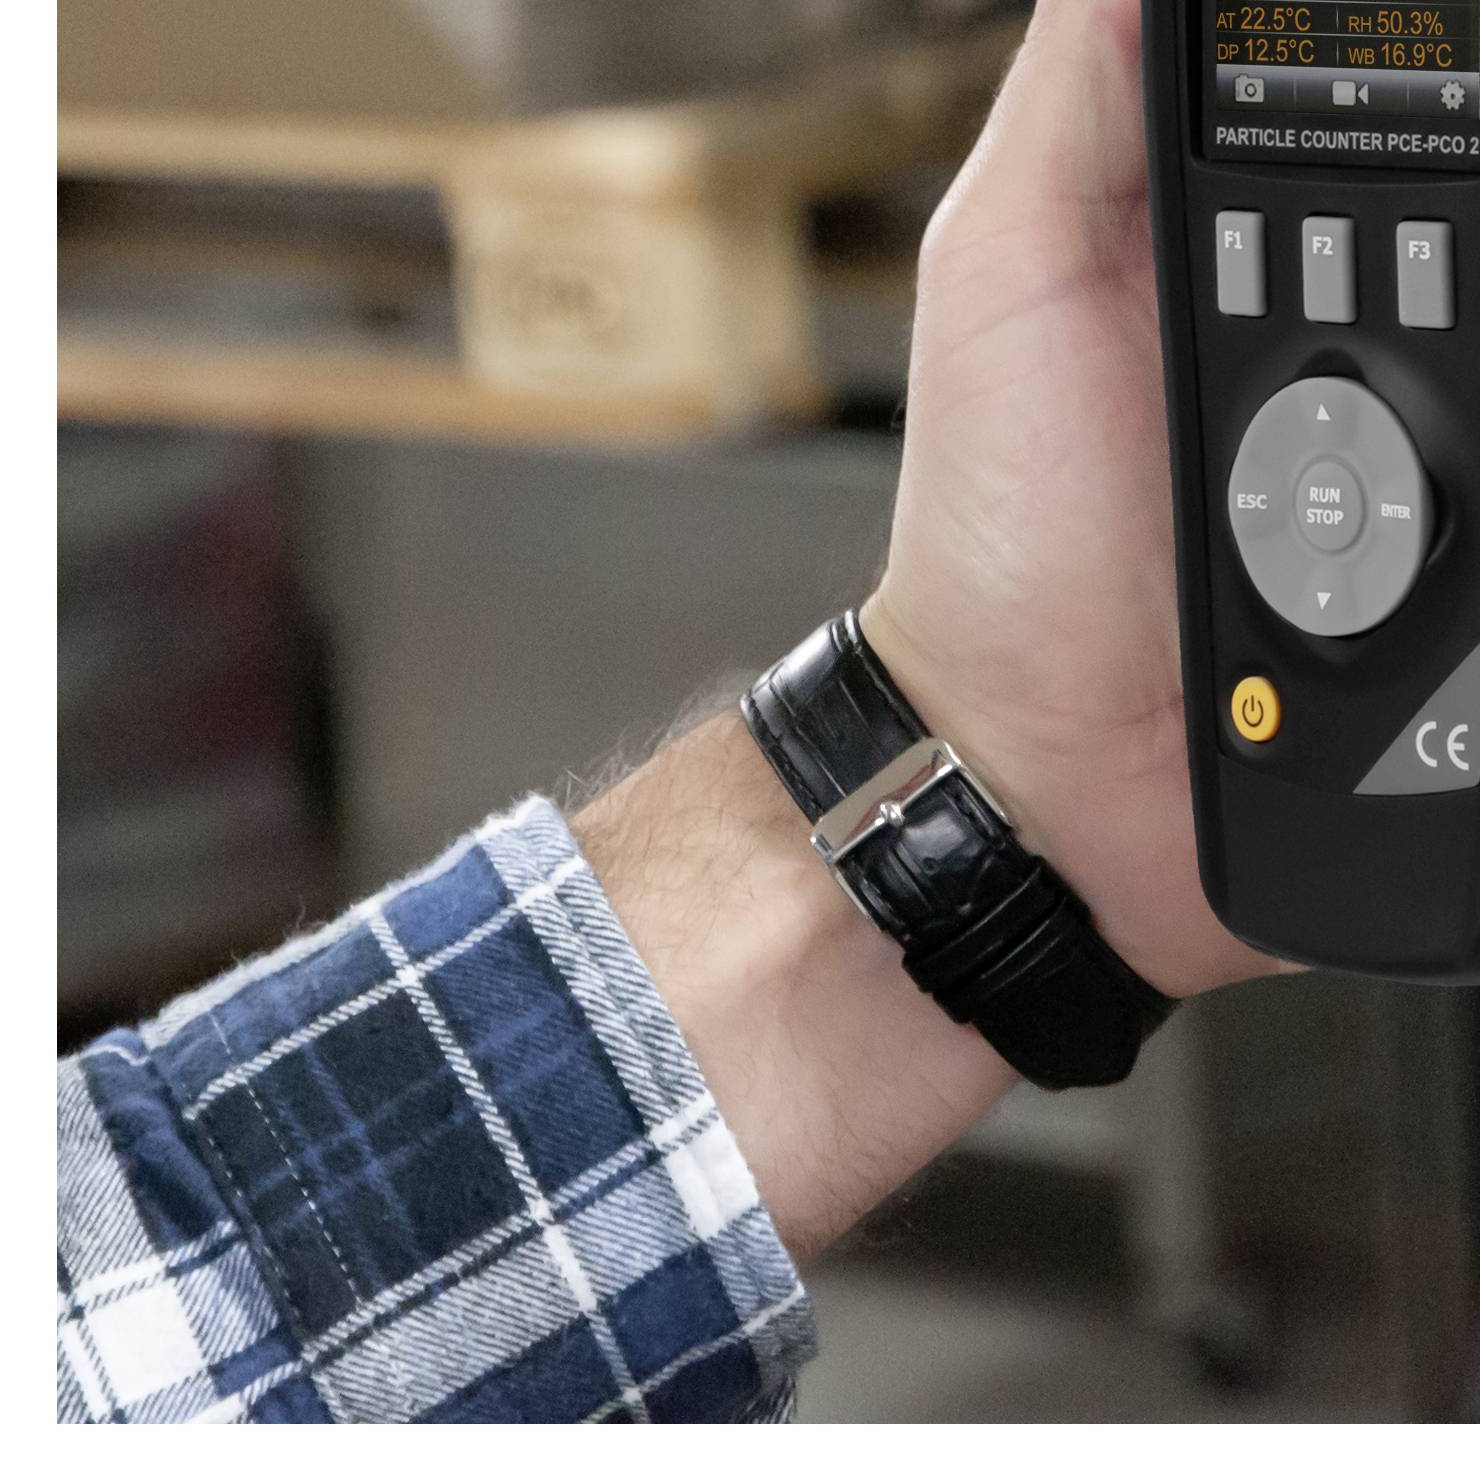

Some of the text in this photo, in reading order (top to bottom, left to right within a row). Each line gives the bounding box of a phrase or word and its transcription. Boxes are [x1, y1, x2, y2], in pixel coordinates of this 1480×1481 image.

[1216, 6, 1311, 33] AT 22.5°C
[1348, 10, 1443, 37] RH 50.3%
[1217, 38, 1315, 64] DP 12.5°C
[1348, 42, 1453, 68] WB 16.9°C
[1216, 126, 1480, 155] PARTICLE COUNTER PCE-PCO 2
[1224, 230, 1243, 250] F1
[1312, 235, 1334, 256] F2
[1408, 240, 1431, 260] F3
[1237, 493, 1268, 510] ESC
[1309, 486, 1341, 503] RUN
[1306, 508, 1344, 526] STOP
[1381, 503, 1411, 520] ENTER
[1415, 720, 1470, 771] CE
